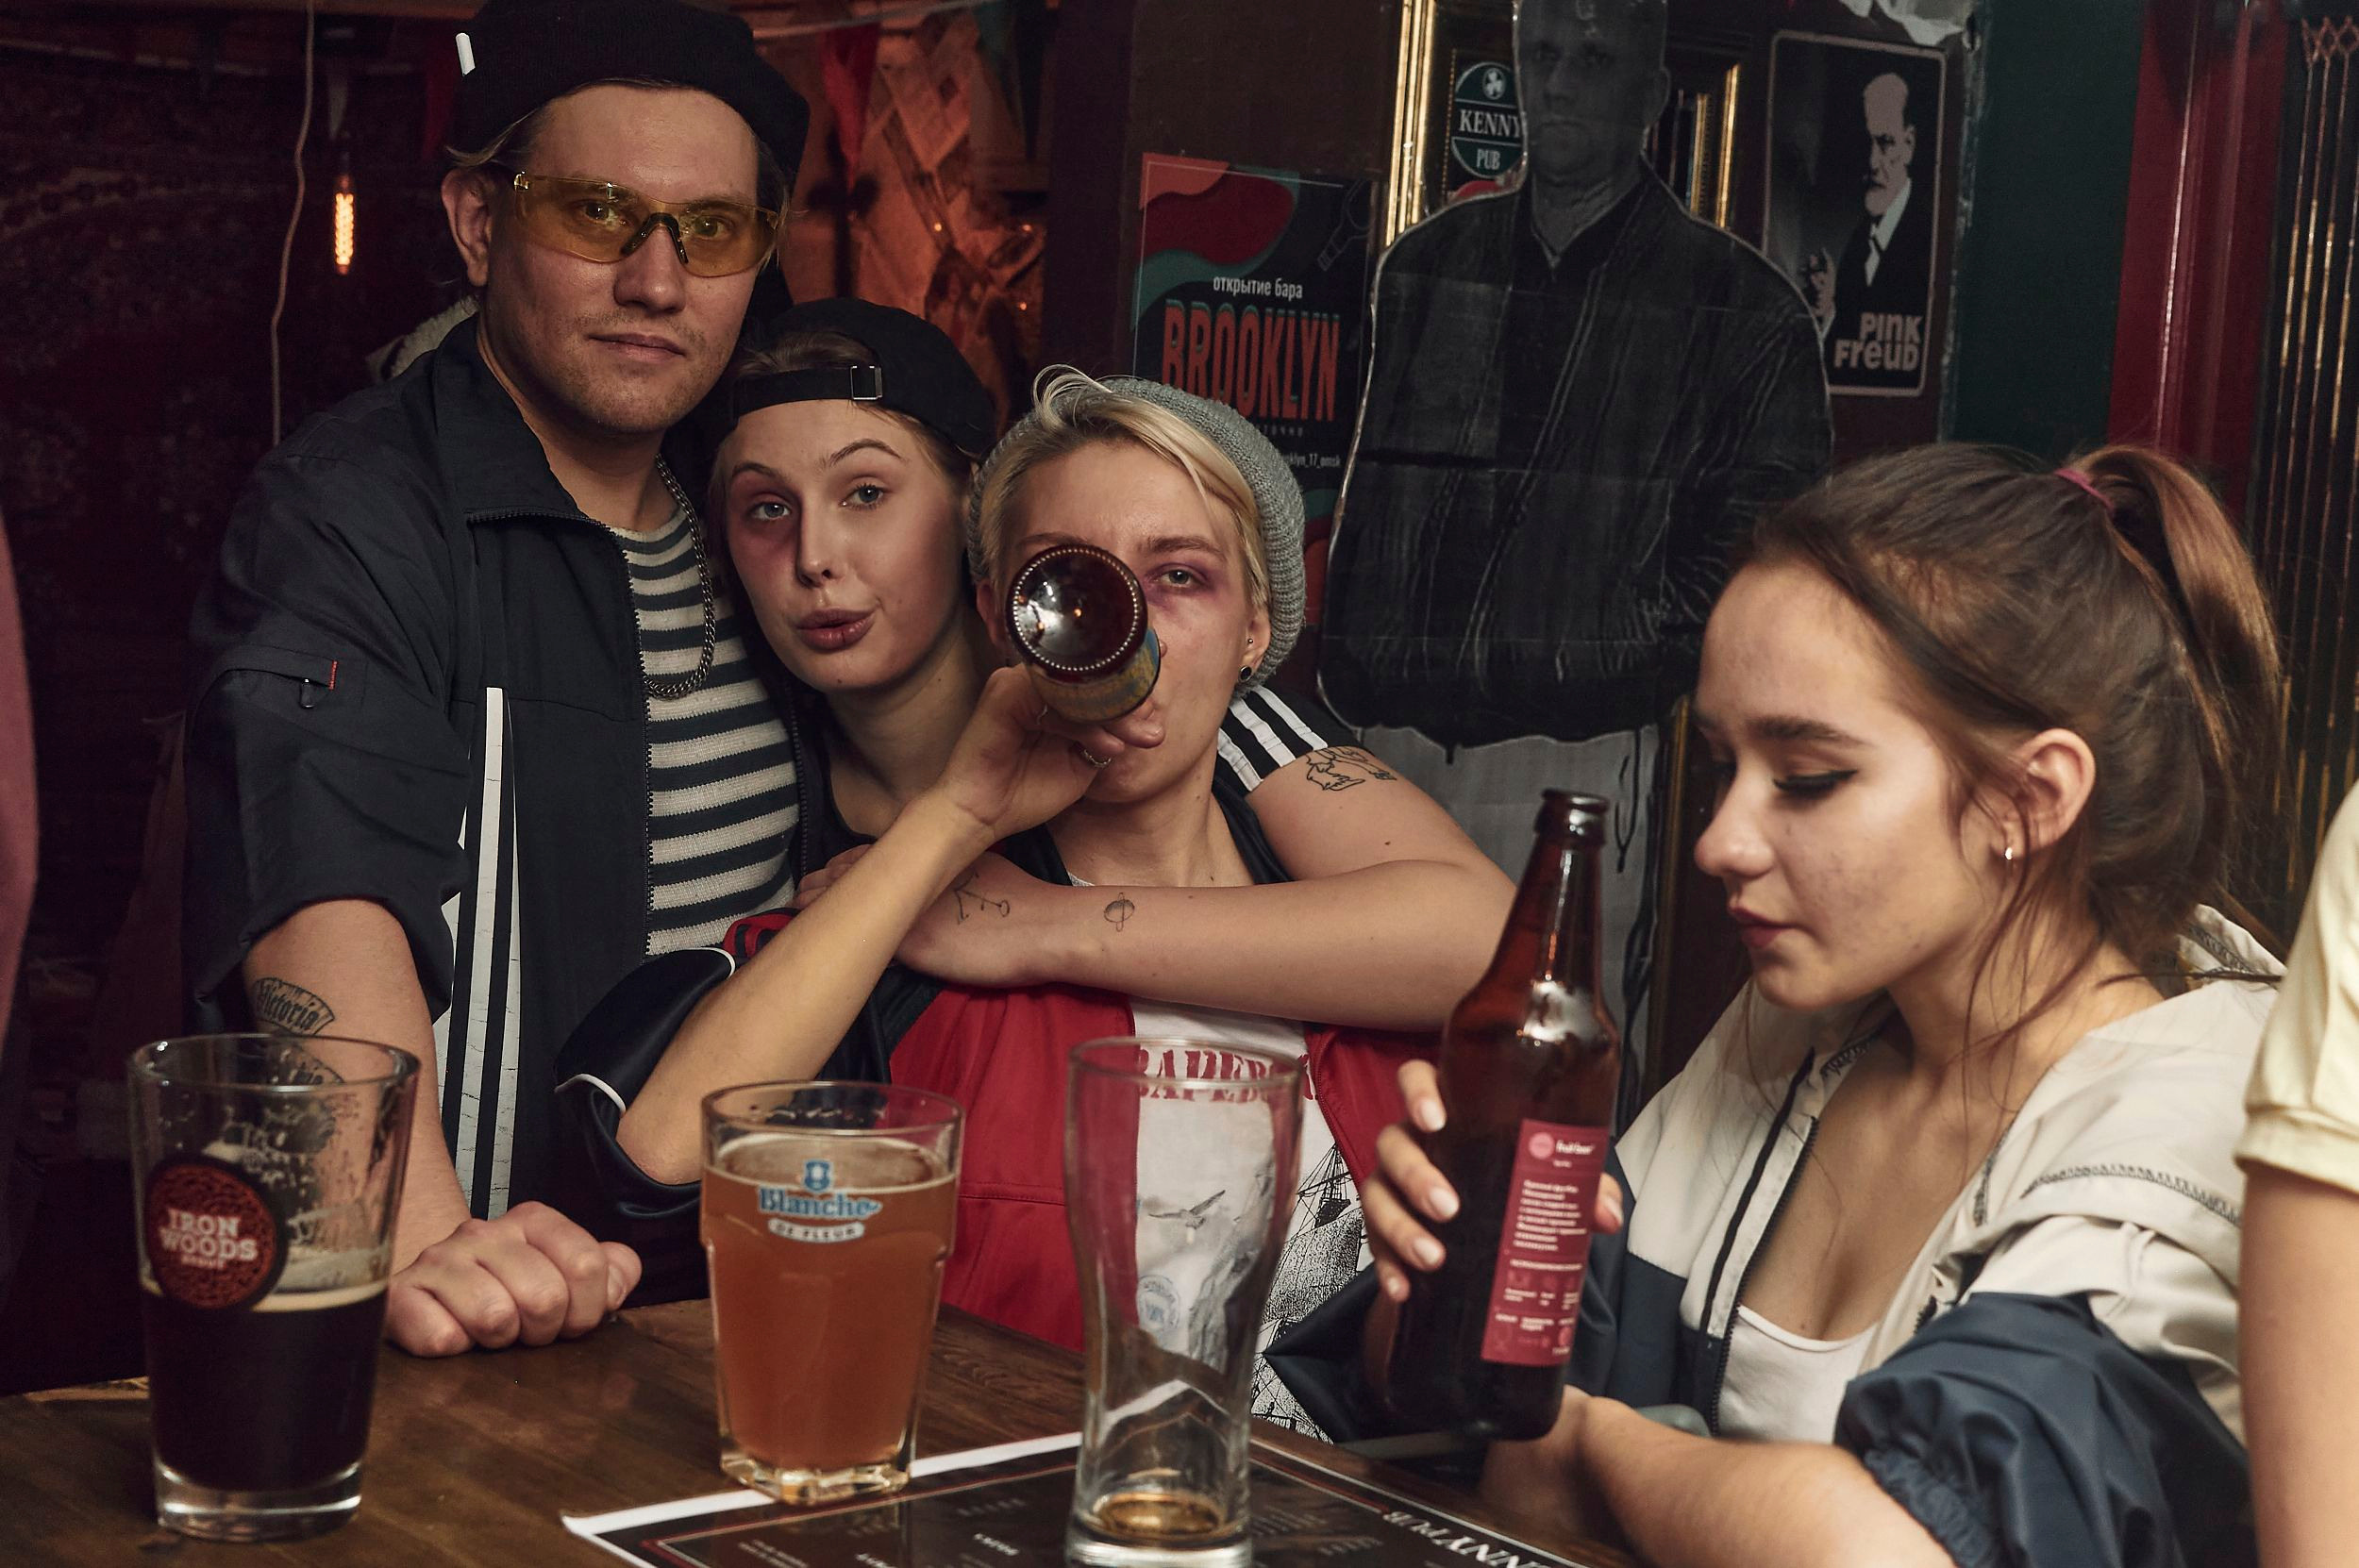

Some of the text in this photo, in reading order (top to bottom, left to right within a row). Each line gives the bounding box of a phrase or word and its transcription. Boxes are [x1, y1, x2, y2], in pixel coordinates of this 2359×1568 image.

[1459, 108, 1522, 139] KENNY
[1476, 148, 1501, 170] PUB
[1213, 276, 1304, 302] открытие бара
[1162, 299, 1341, 422] BROOKLYN
[759, 1187, 882, 1219] Blanche
[168, 1208, 242, 1239] IRON
[159, 1226, 259, 1261] WOODS
